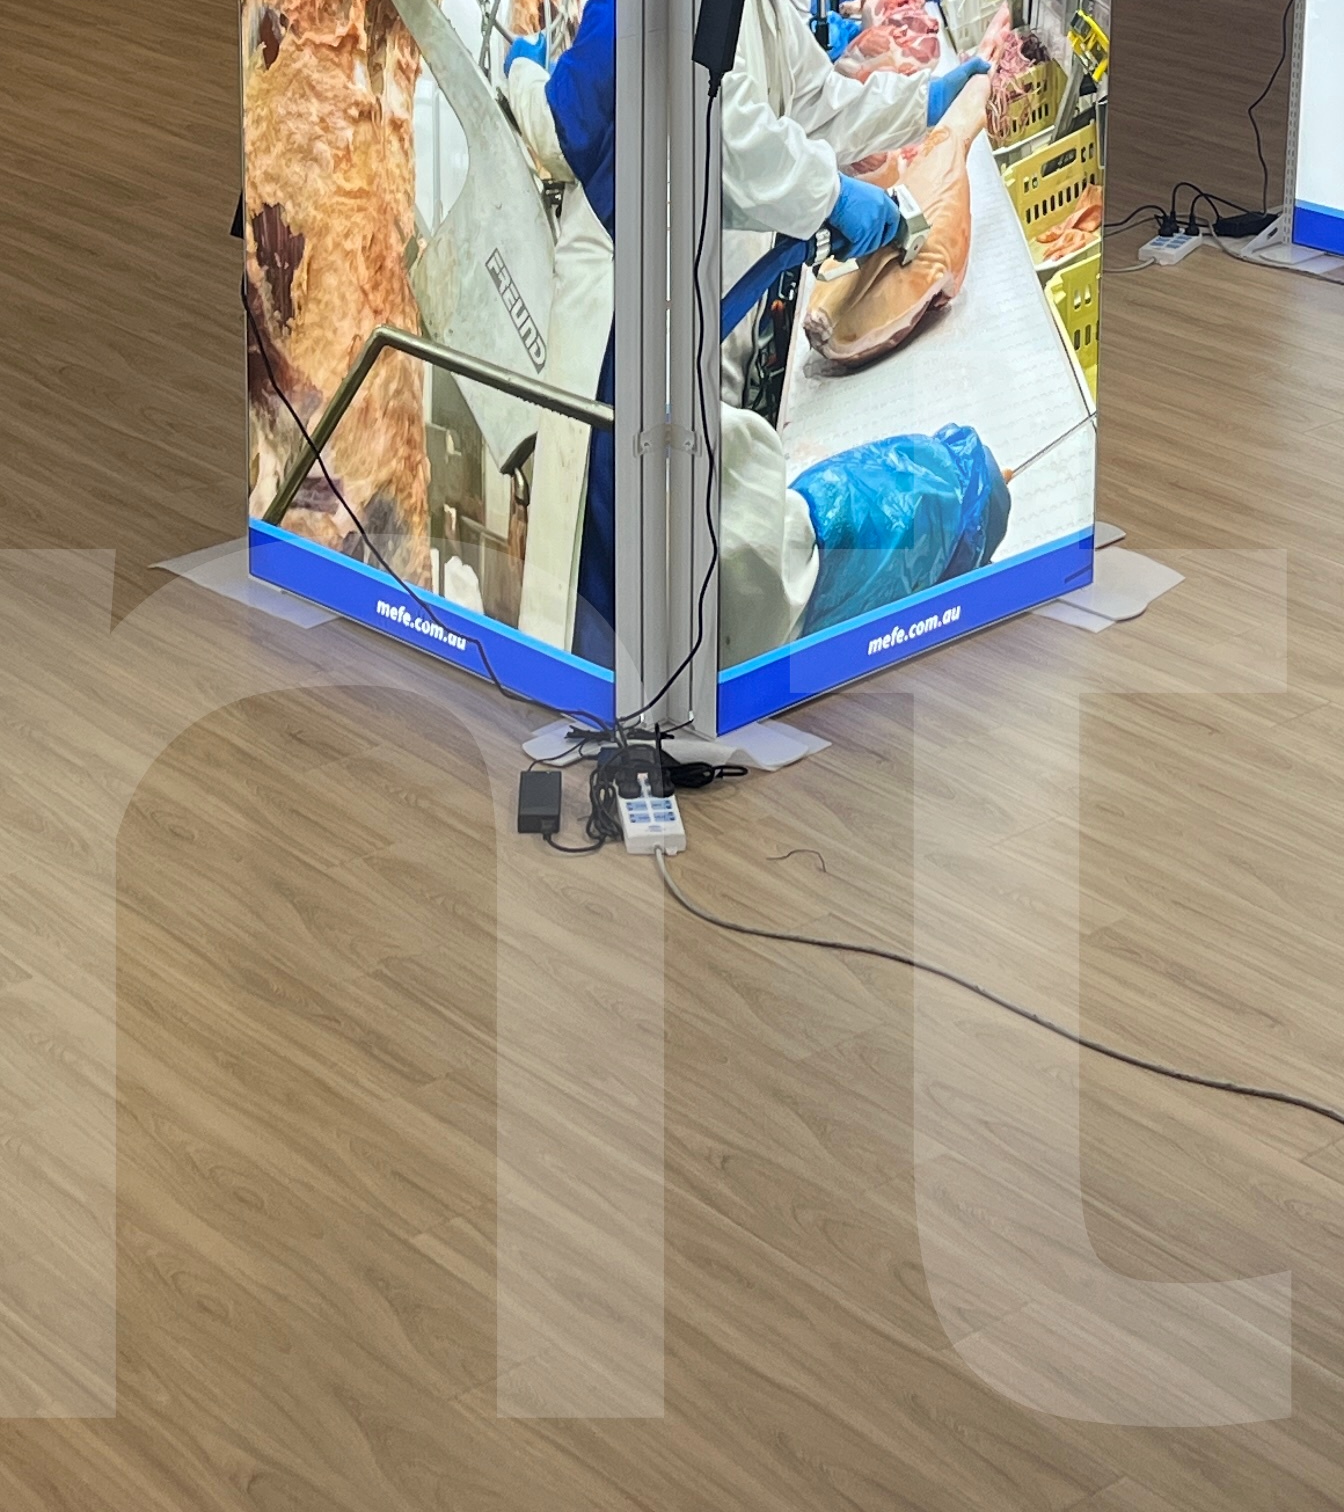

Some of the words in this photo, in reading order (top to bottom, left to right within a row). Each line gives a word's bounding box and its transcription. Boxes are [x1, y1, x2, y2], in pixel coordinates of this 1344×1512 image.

[485, 248, 548, 374] FREUND
[376, 599, 467, 651] mefe.com.au
[867, 605, 961, 656] mefe.com.au
